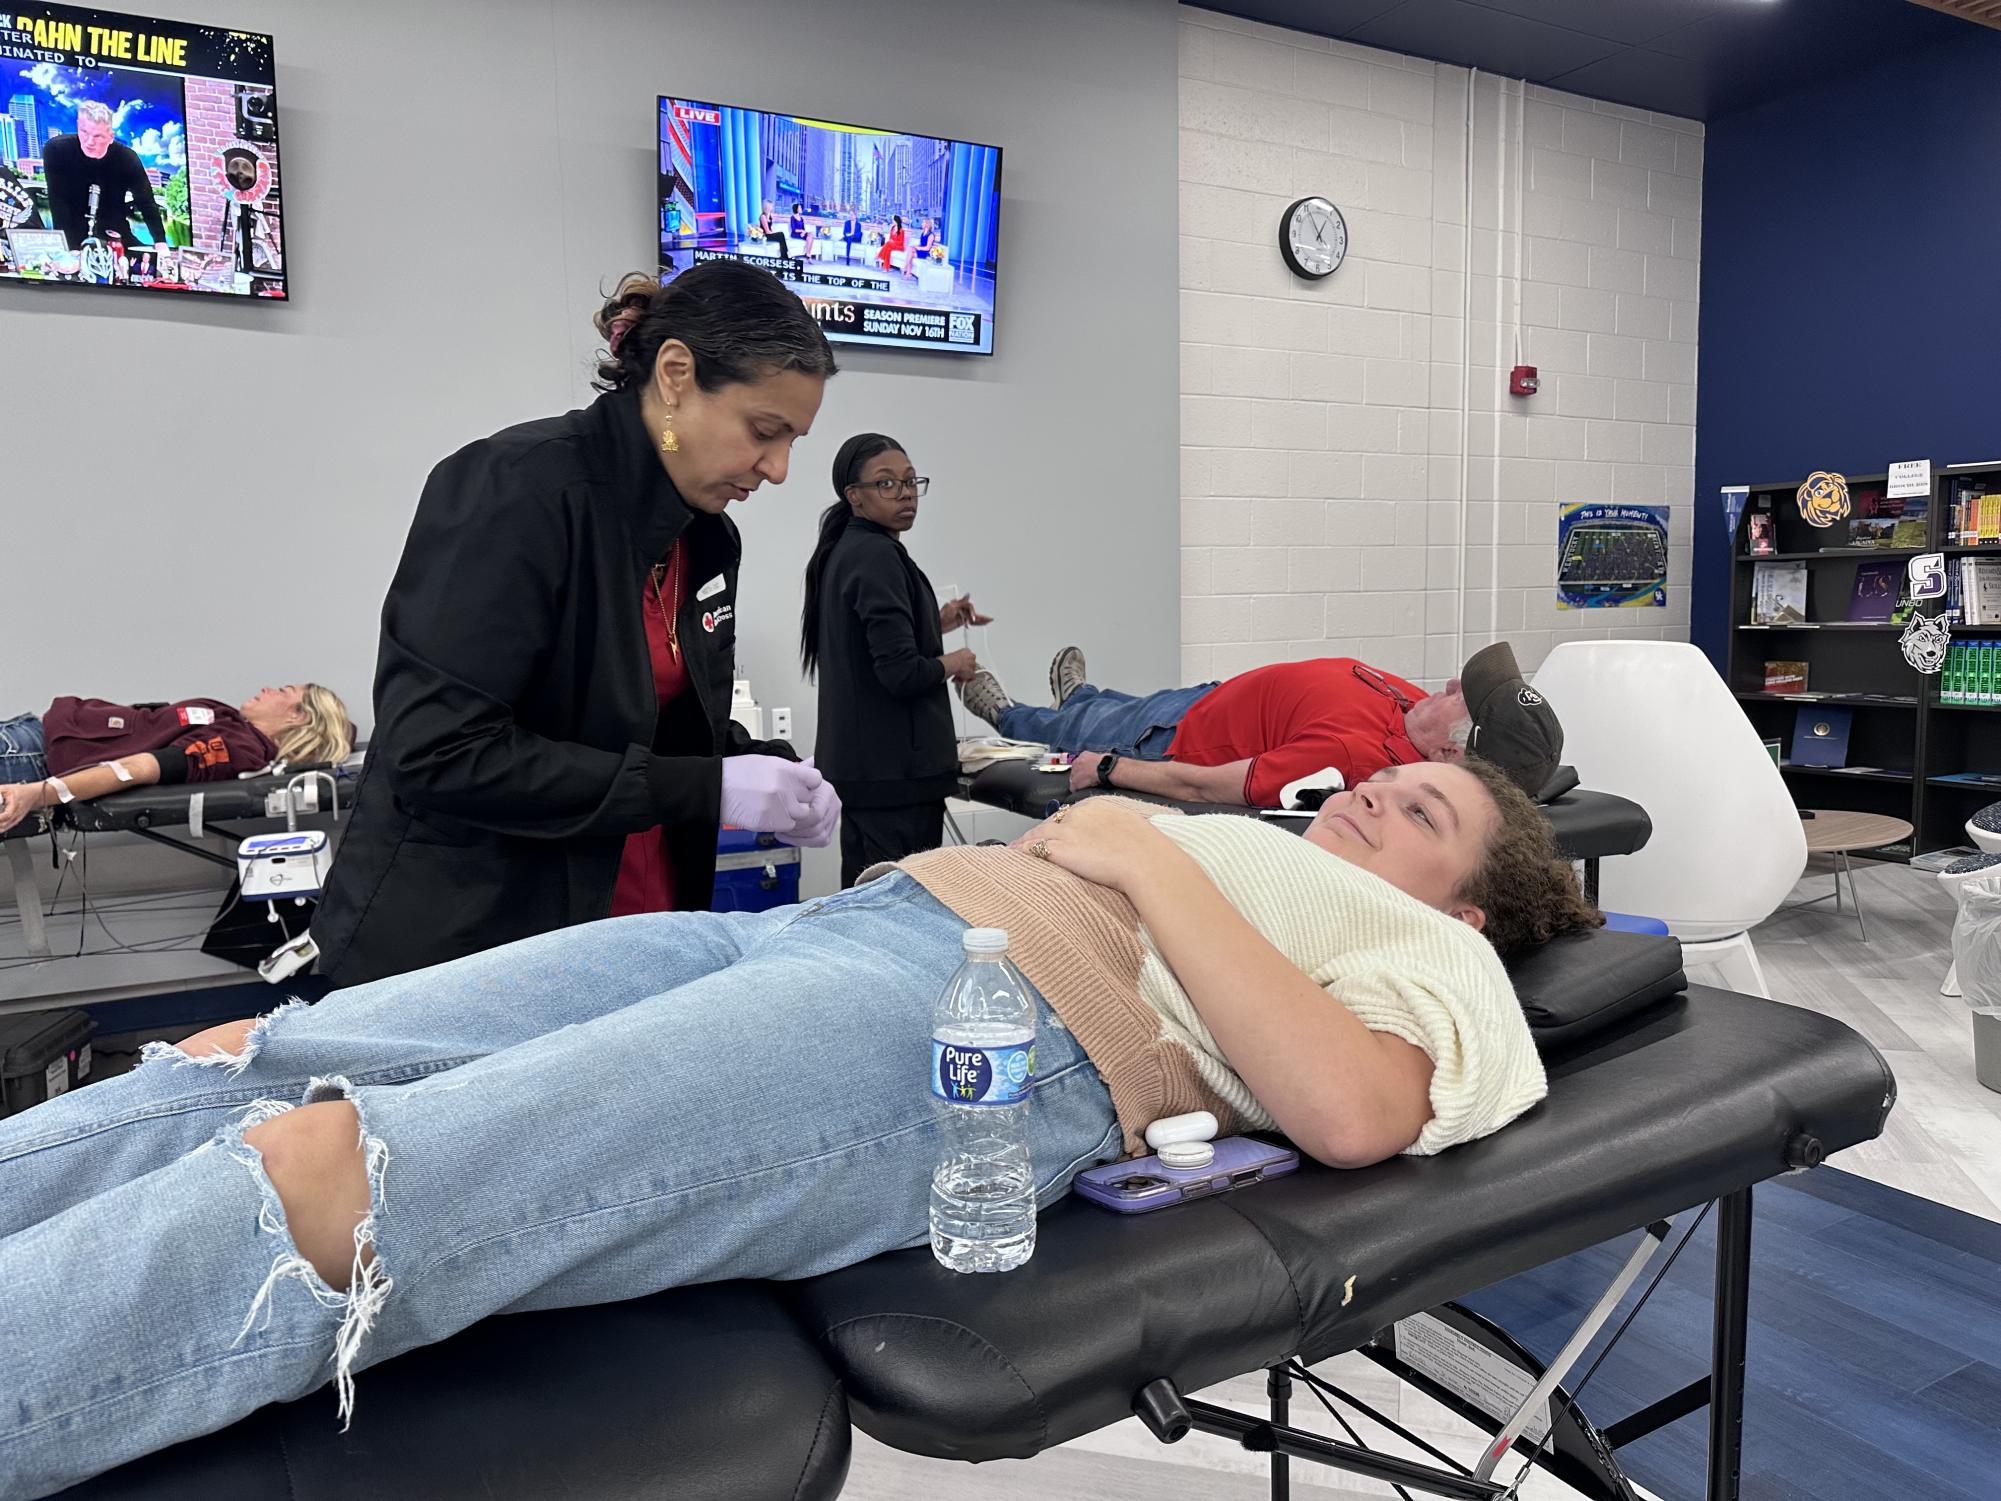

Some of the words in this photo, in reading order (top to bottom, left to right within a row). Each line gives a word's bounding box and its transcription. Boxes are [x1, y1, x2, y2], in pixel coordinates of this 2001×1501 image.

[87, 26, 133, 59] THE
[137, 33, 188, 67] LINE
[0, 45, 65, 63] INATED
[74, 55, 97, 68] TO
[680, 109, 716, 122] LIVE
[742, 256, 801, 270] SCORSESE.
[782, 271, 796, 281] IS
[802, 274, 821, 284] THE
[827, 276, 846, 286] TOP
[851, 279, 864, 288] OF
[870, 281, 889, 291] THE
[863, 308, 902, 322] SEASON
[903, 312, 946, 326] PREMIERE
[949, 315, 975, 331] FOX
[863, 320, 900, 335] SUNDAY
[901, 324, 922, 337] NOV
[924, 326, 945, 338] 16TH
[949, 330, 974, 339] NATION
[1908, 552, 1948, 601] S
[946, 1046, 983, 1066] Pure
[949, 1064, 977, 1085] Life
